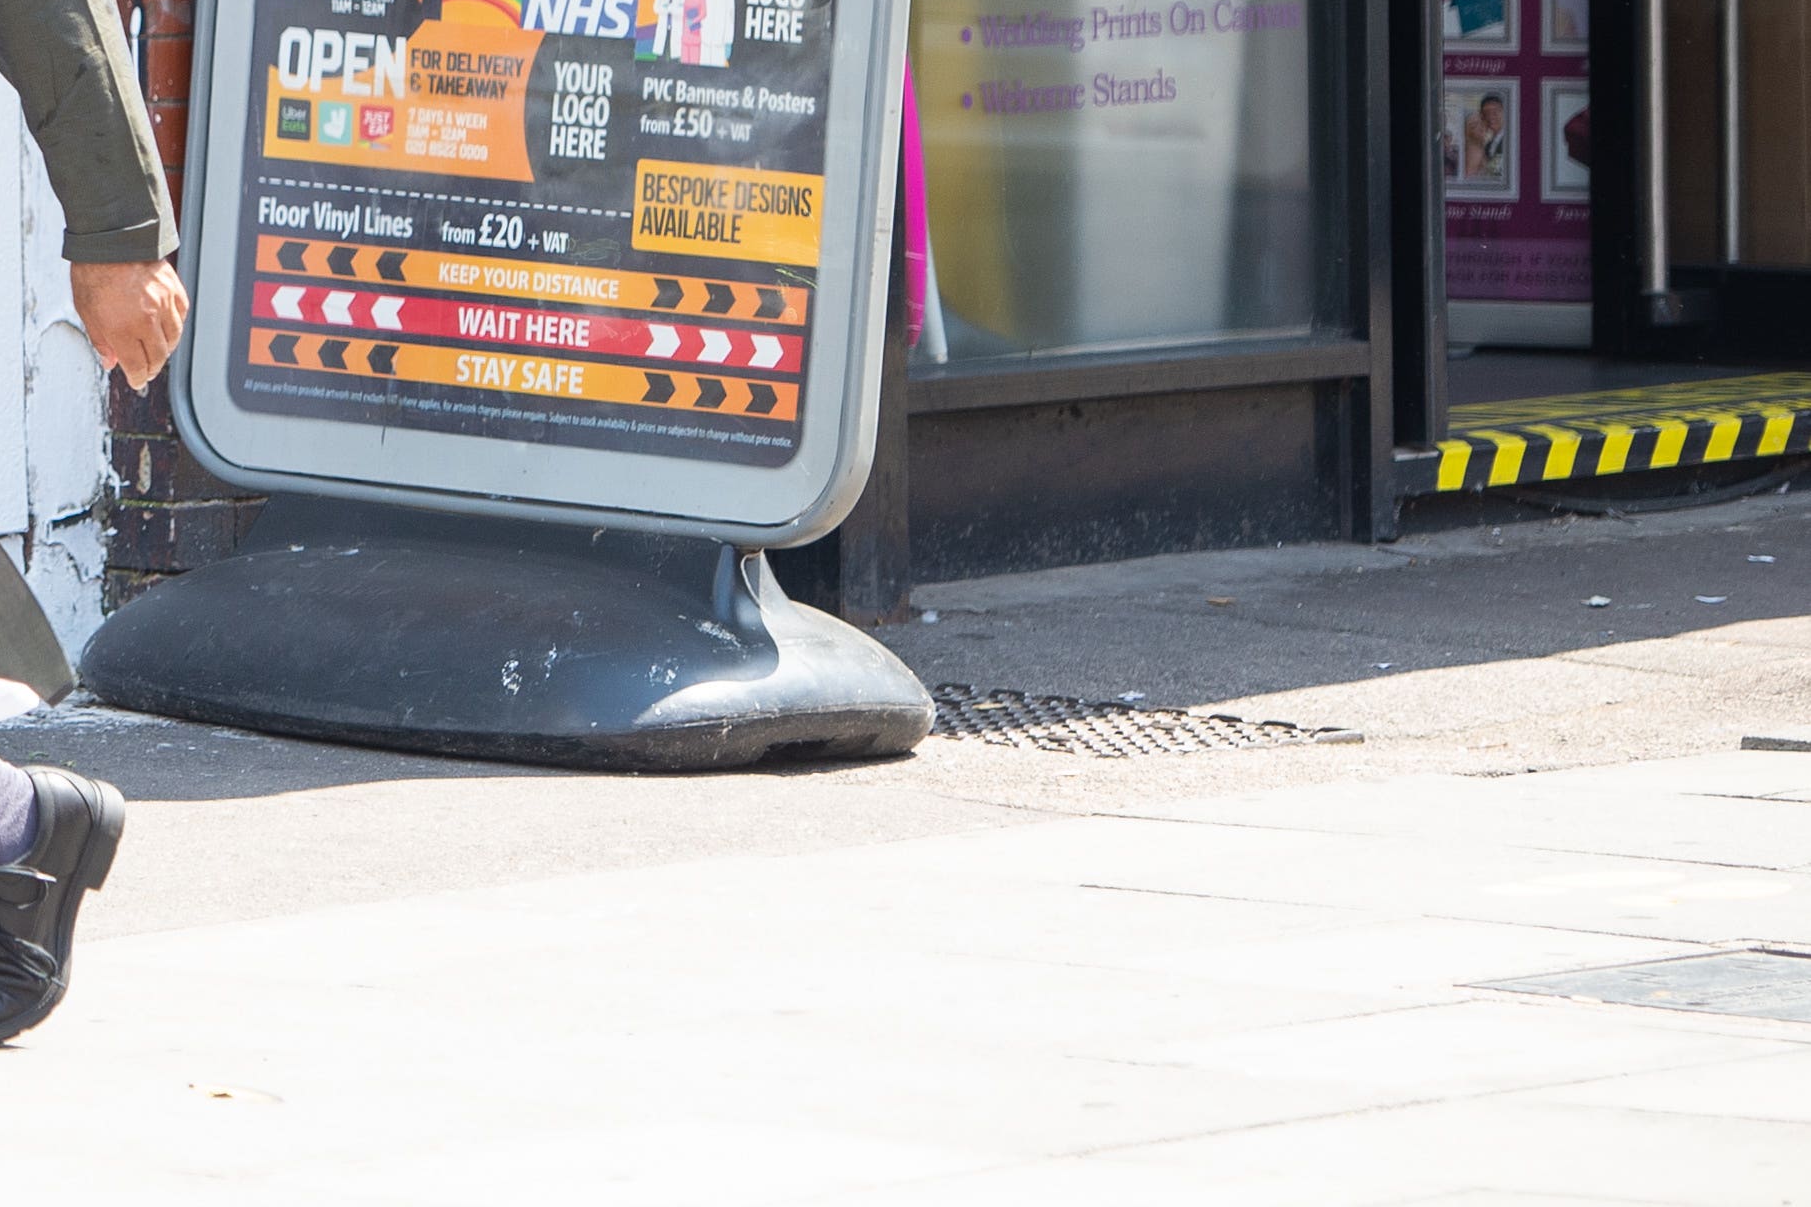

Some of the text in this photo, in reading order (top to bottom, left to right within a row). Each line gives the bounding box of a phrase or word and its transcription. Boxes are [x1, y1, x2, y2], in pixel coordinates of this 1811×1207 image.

[745, 6, 804, 43] HERE
[1091, 5, 1162, 42] Prints
[1169, 0, 1205, 36] On
[278, 26, 407, 100] OPEN
[411, 48, 525, 78] FOR DELIVERY
[554, 61, 613, 96] YOUR
[428, 74, 508, 100] TAKEAWAY
[643, 77, 816, 115] PVC Banners & Posters
[1093, 68, 1177, 108] Stands
[364, 110, 390, 126] JUST
[367, 123, 389, 136] EAT
[552, 94, 610, 128] LOGO
[640, 107, 752, 142] from £50 VAT
[550, 126, 607, 161] HERE
[643, 173, 812, 217] BESPOKE DESIGNS
[258, 196, 570, 254] Floor Vinyl Lines from £20 + VAT
[640, 206, 743, 244] AVAILABLE
[439, 262, 619, 300] KEEP YOUR DISTANCE
[458, 307, 590, 347] WAIT HERE
[456, 354, 584, 395] STAY SAFE
